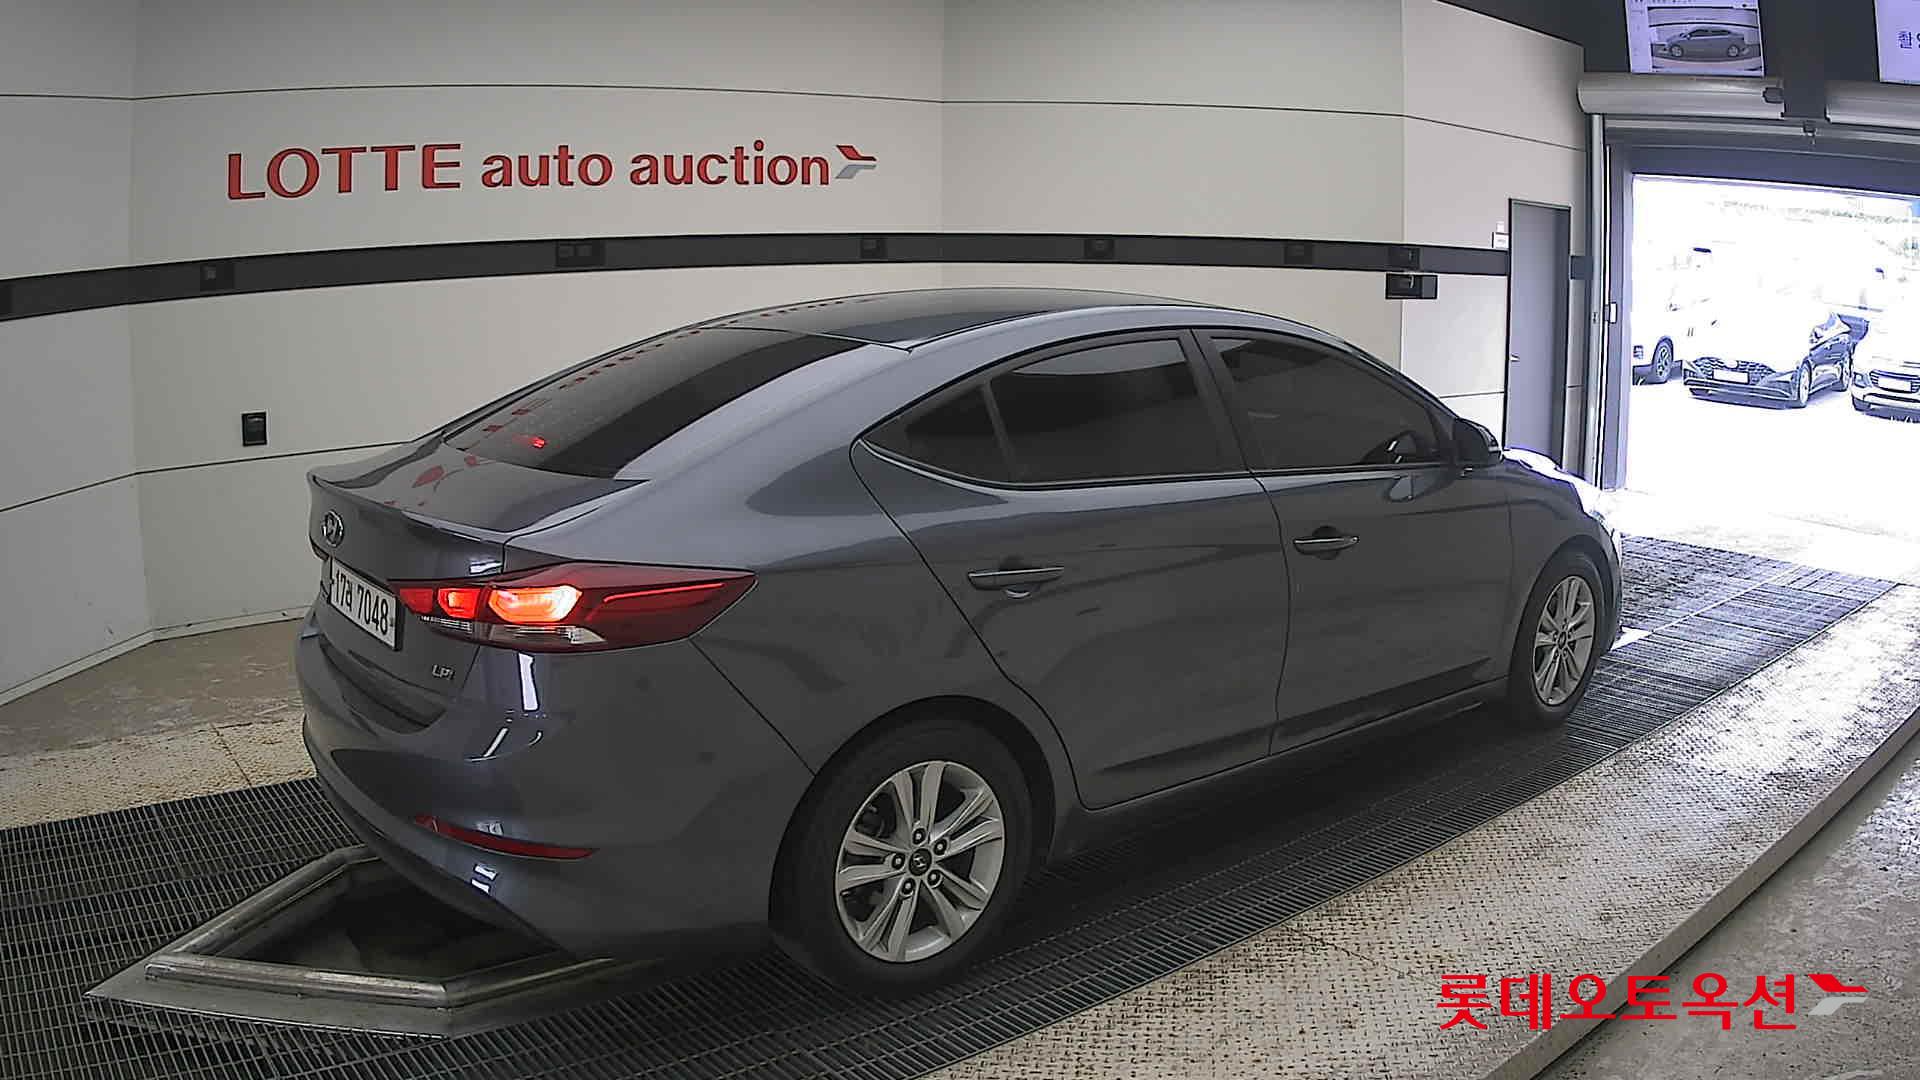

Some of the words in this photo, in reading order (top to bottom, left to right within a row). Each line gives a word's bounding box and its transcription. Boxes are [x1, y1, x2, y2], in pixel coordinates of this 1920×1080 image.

[227, 143, 461, 200] LOTTE
[481, 145, 614, 188] auto
[629, 140, 831, 186] auction
[357, 583, 389, 636] 7048
